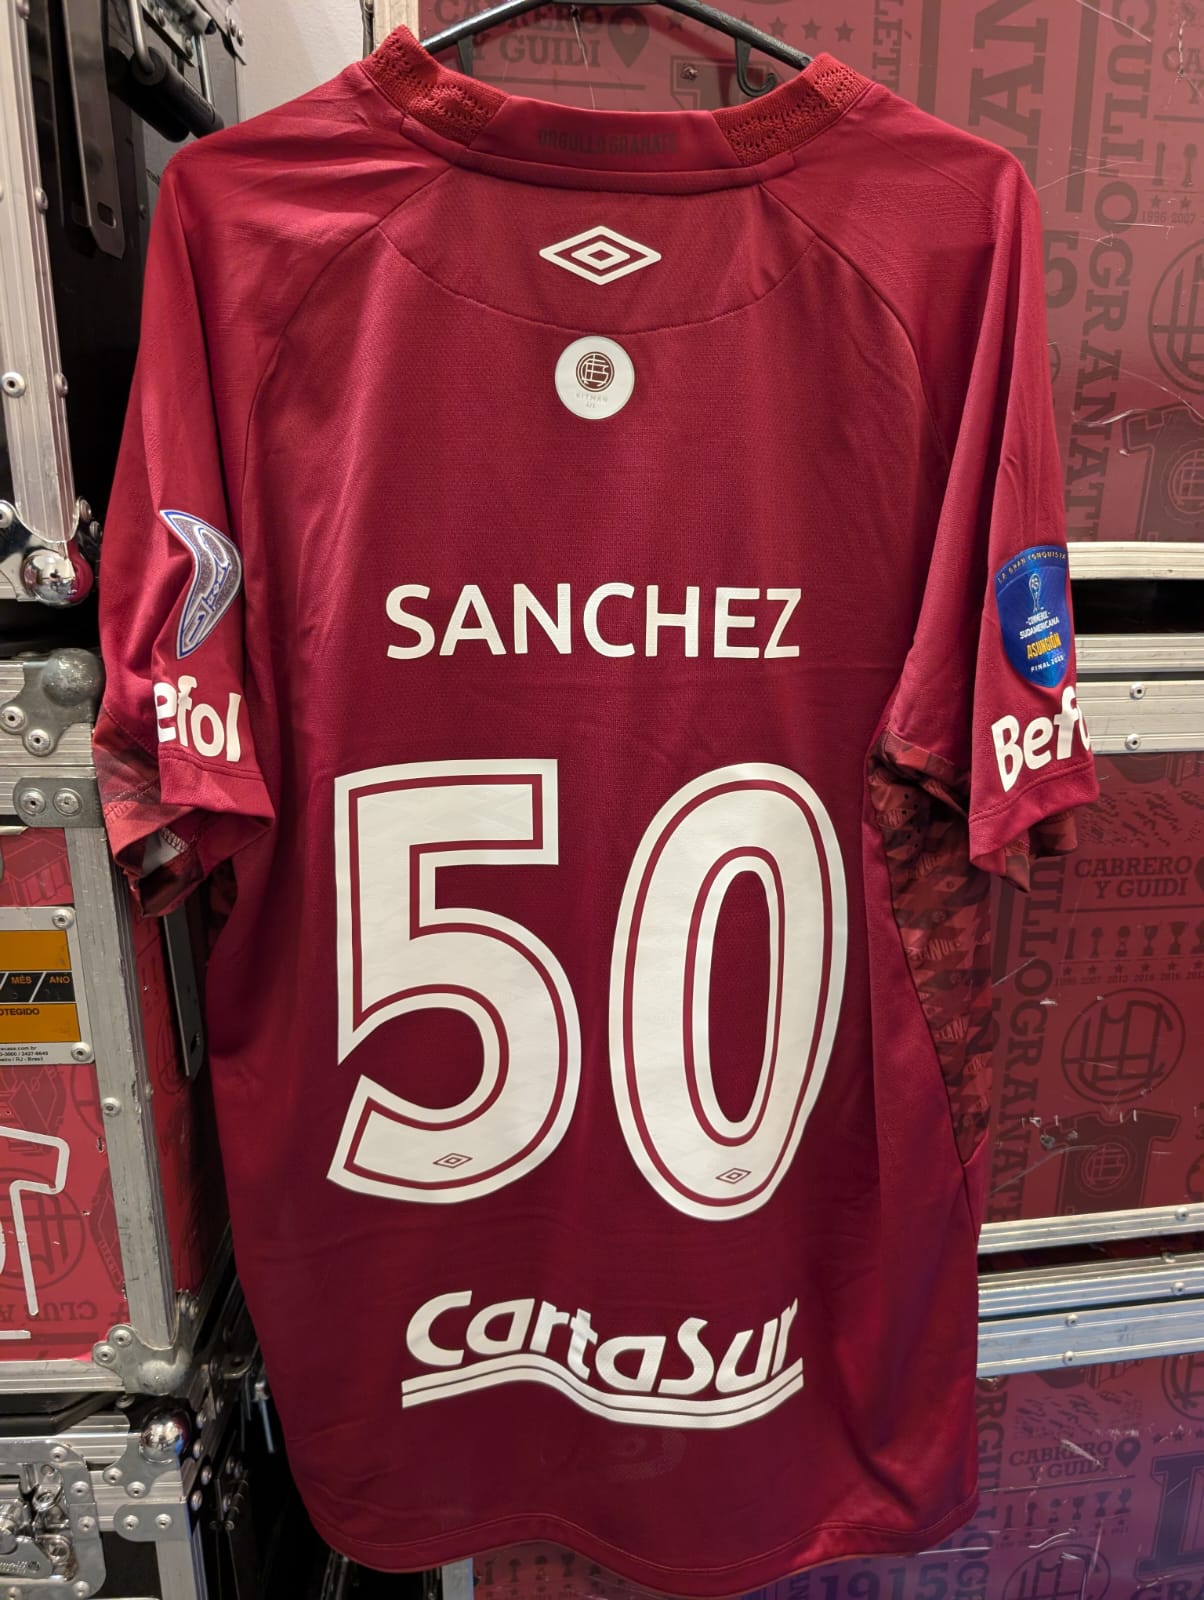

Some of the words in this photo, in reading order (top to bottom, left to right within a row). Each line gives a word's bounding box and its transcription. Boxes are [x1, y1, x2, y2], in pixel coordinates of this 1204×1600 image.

[385, 582, 802, 660] SANCHEZ
[1026, 631, 1062, 660] ASUNCIÓN
[1074, 855, 1193, 878] CABRERO
[1093, 879, 1113, 900] Y
[1116, 877, 1189, 899] GUIDI
[11, 973, 33, 985] MÊS
[49, 975, 71, 985] ANO
[326, 758, 849, 1223] 50
